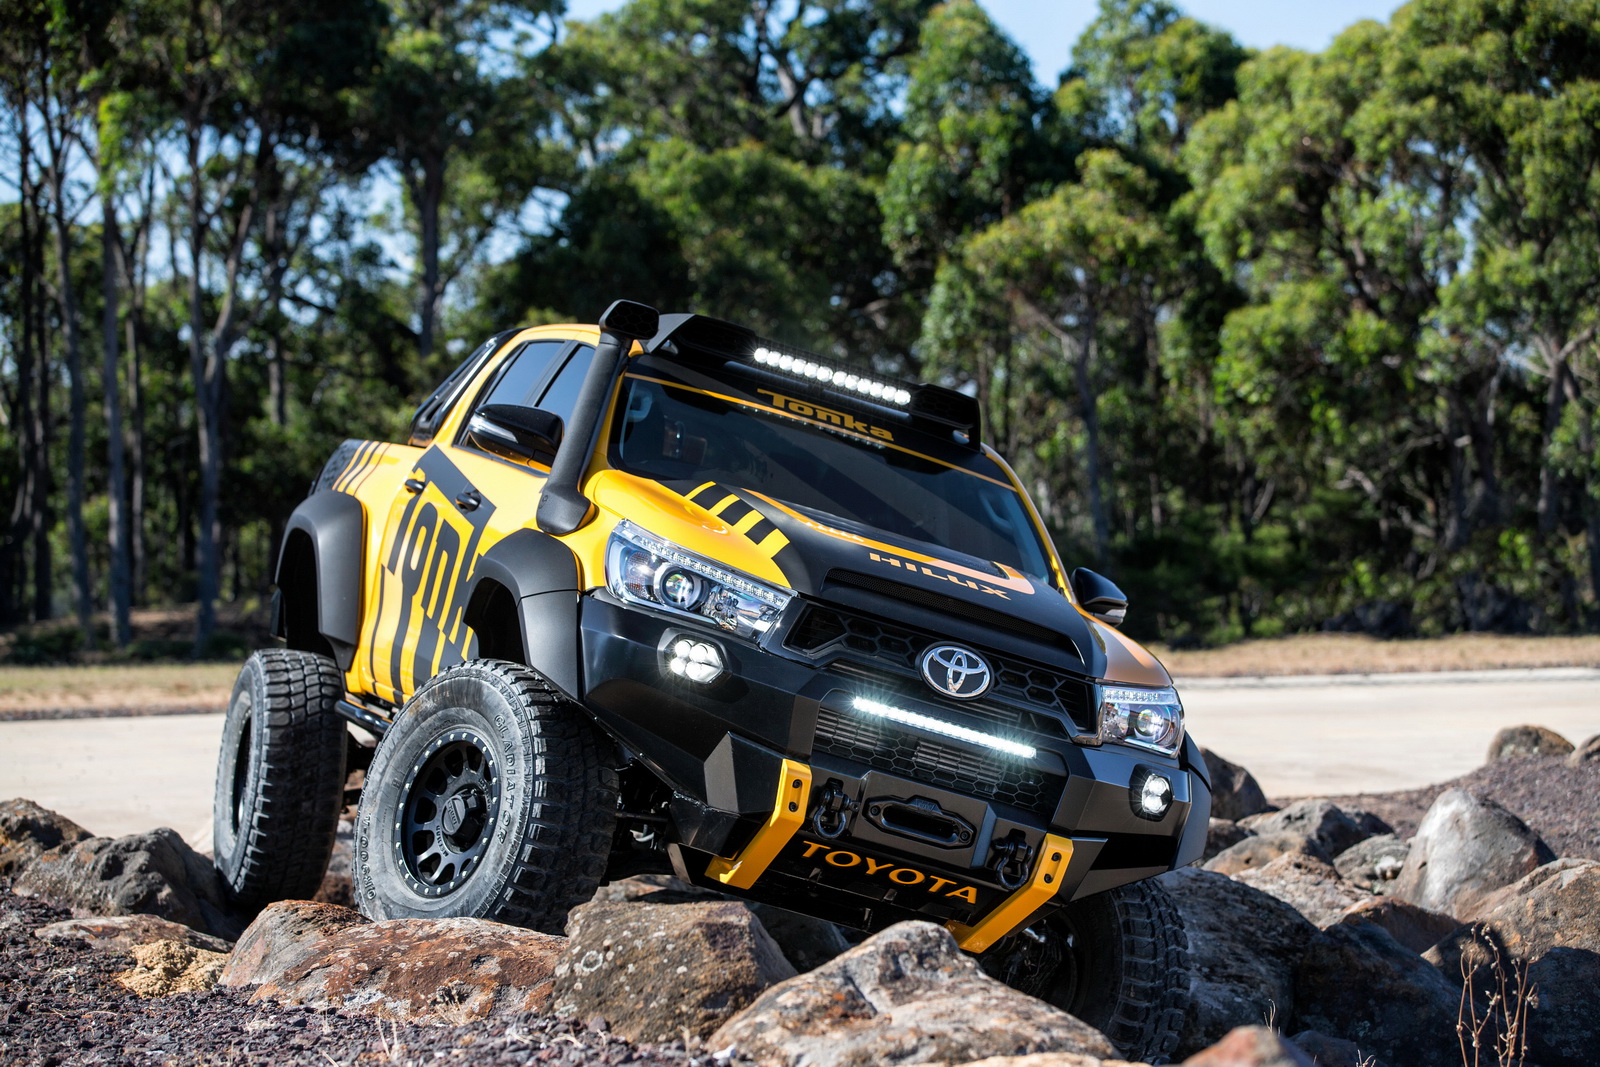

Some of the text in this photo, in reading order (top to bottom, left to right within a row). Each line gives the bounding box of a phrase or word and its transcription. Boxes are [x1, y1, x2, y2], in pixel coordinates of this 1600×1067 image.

[757, 388, 894, 441] Tonka
[870, 552, 1011, 600] HILUX
[493, 714, 516, 844] GLADIATOR
[802, 840, 978, 904] TOYOTA
